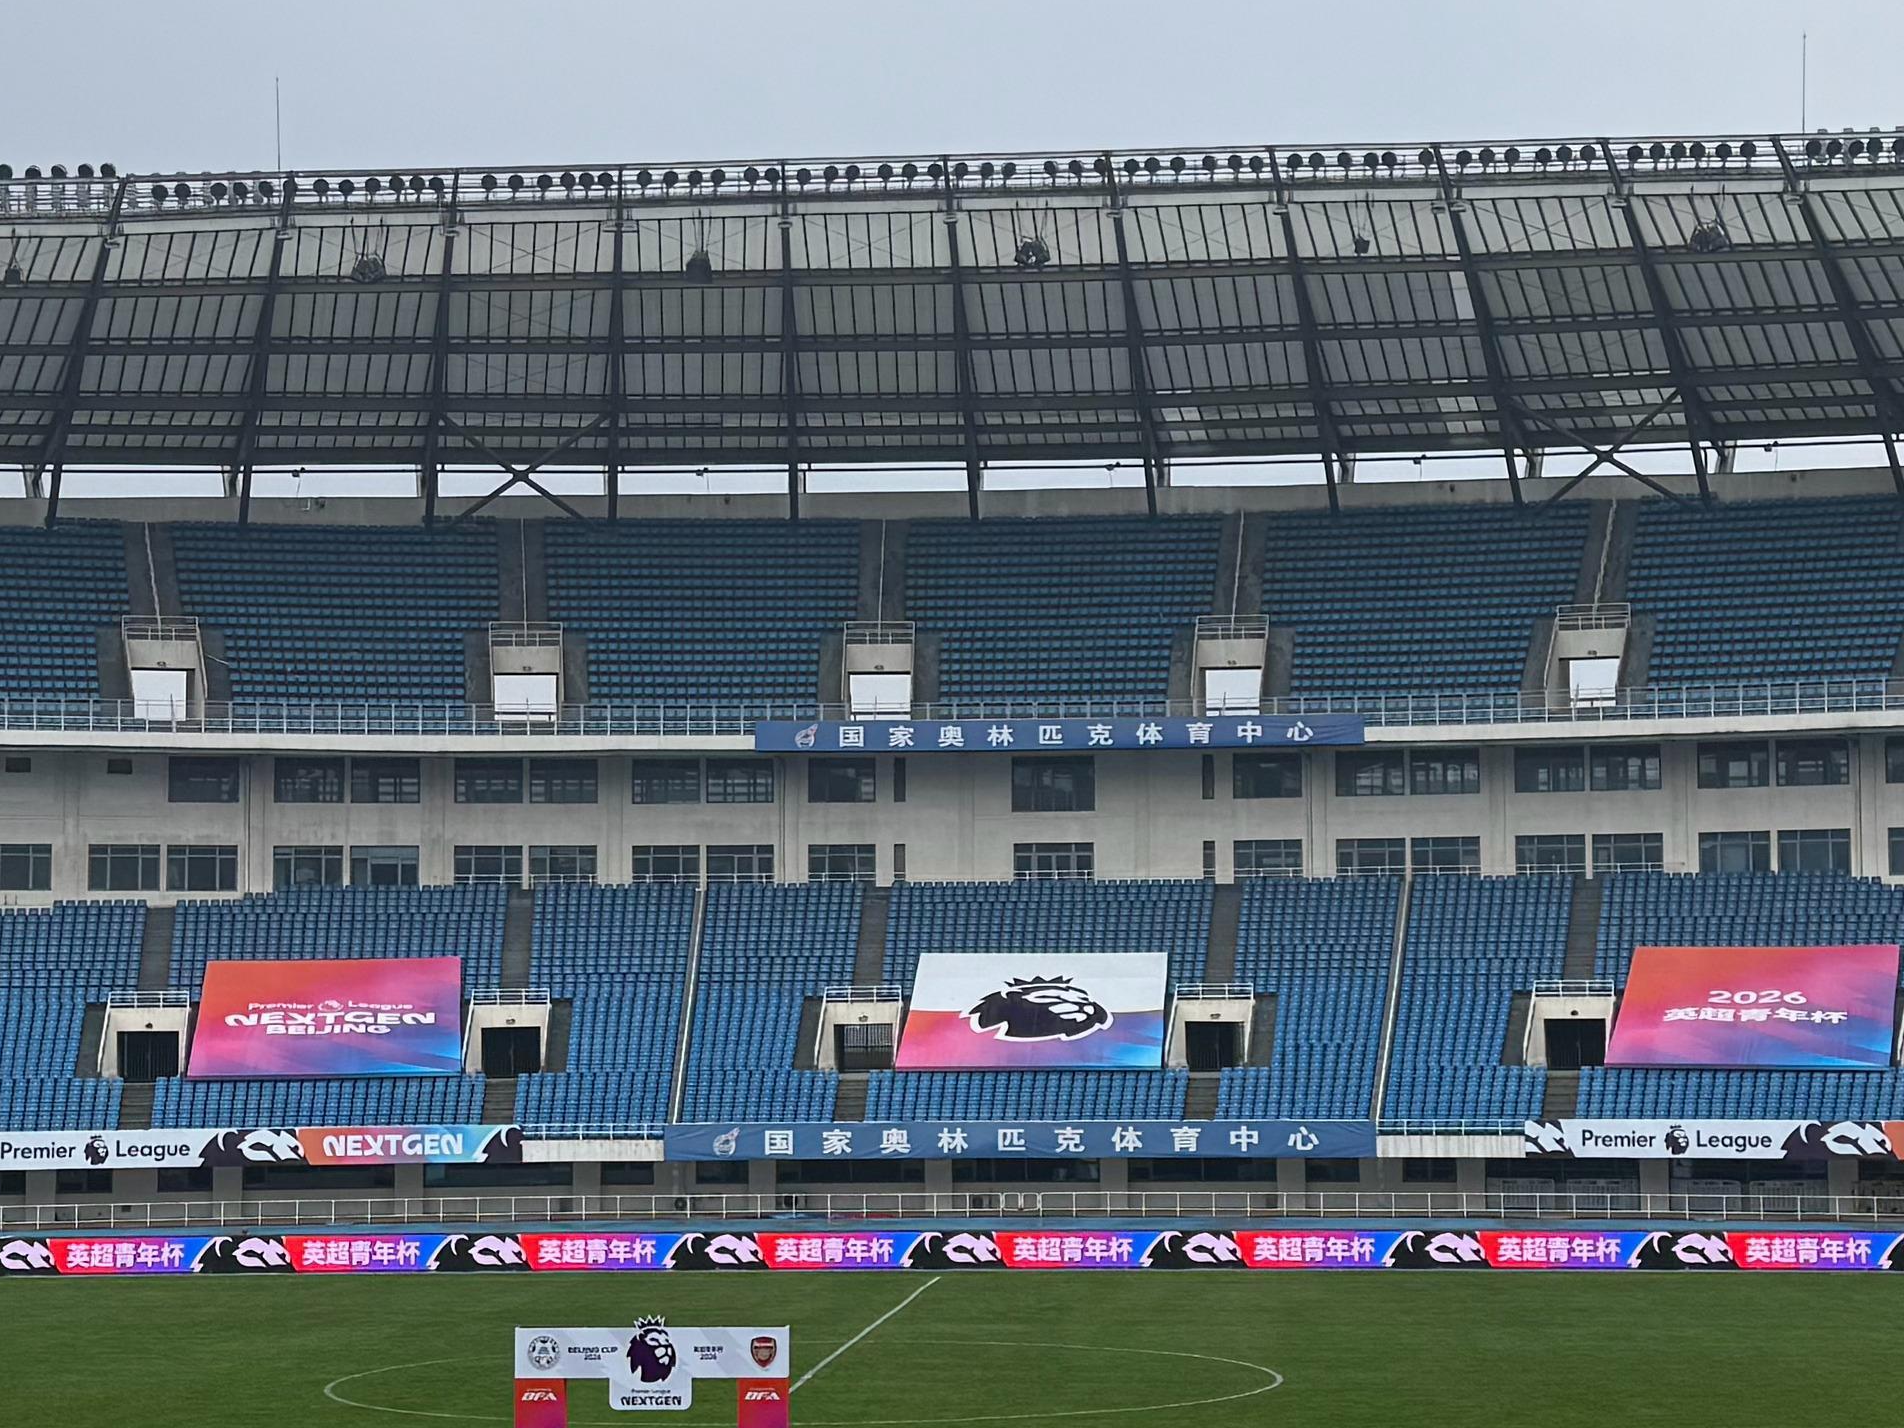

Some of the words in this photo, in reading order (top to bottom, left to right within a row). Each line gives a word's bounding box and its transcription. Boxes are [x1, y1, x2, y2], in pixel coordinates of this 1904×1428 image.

[839, 722, 1315, 748] 国家奥林匹克体育中心
[248, 1000, 313, 1011] Premier
[348, 999, 414, 1012] League
[1708, 990, 1807, 1005] 2026
[224, 1012, 435, 1027] NEXTGEN
[1663, 1007, 1848, 1024] 英超青年杯
[266, 1024, 392, 1036] BEIJING
[0, 1141, 77, 1160] Premier
[114, 1141, 190, 1161] League
[322, 1134, 464, 1157] NEXTGEN
[764, 1126, 1320, 1157] 国家奥林匹克体育中心
[1580, 1128, 1657, 1149] Premier
[1696, 1128, 1773, 1153] League
[66, 1243, 185, 1269] 英超青年杯
[301, 1240, 421, 1266] 英超青年杯
[538, 1239, 657, 1265] 英超青年杯
[773, 1237, 893, 1264] 英超青年杯
[1013, 1236, 1134, 1262] 英超青年杯
[1253, 1236, 1375, 1263] 英超青年杯
[1497, 1236, 1621, 1263] 英超青年杯
[1745, 1237, 1872, 1264] 英超青年杯
[620, 1396, 682, 1406] NEXTGEN
